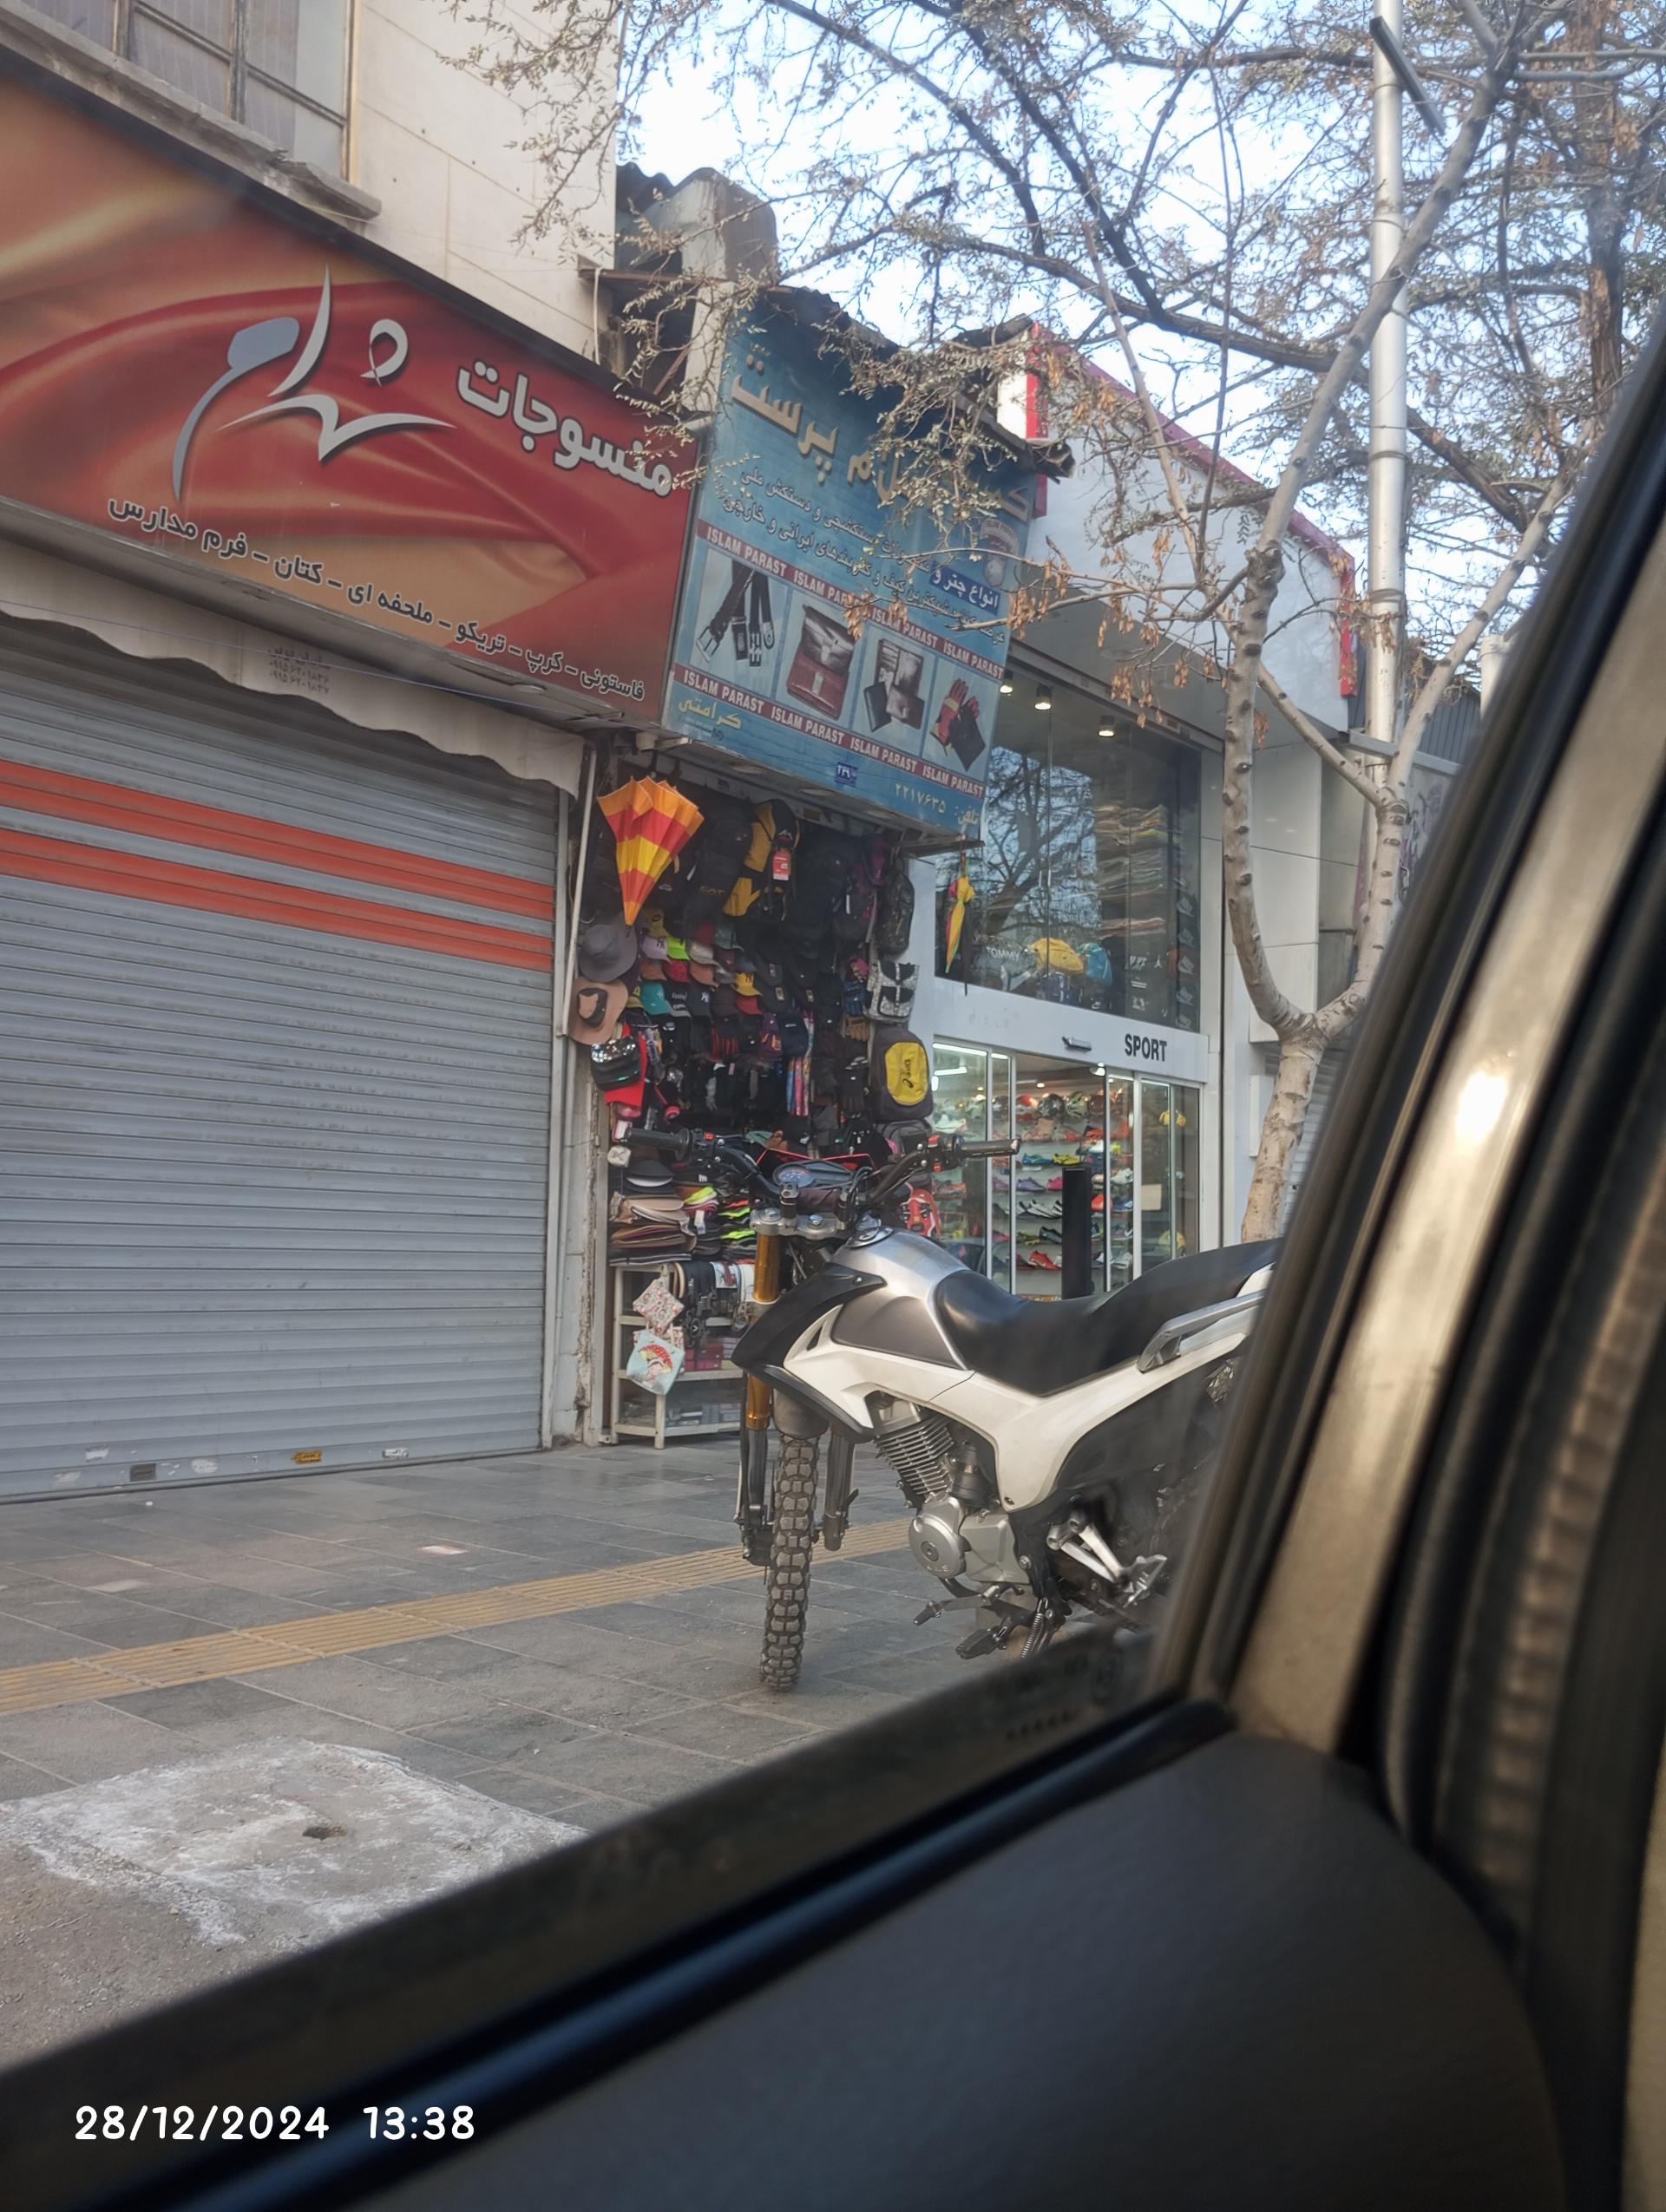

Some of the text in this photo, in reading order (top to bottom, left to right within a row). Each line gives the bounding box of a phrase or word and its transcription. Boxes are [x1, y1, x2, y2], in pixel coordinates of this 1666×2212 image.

[456, 360, 674, 498] منسوجات
[731, 353, 838, 487] پرست
[765, 480, 812, 512] دستکش
[108, 498, 199, 540] مدارس
[767, 517, 777, 534] و
[813, 507, 822, 522] و
[201, 528, 248, 560] فرم
[778, 521, 815, 553] ایرانی
[272, 556, 324, 586] کتان
[815, 540, 873, 577] کربندهای
[346, 582, 373, 605] ای
[873, 571, 882, 587] و
[377, 592, 434, 625] ملحفه
[707, 527, 742, 557] ISLAM
[744, 545, 788, 578] PARAST
[793, 569, 826, 598] ISLAM
[903, 623, 939, 648] PARAST
[942, 638, 971, 664] ISLAM
[970, 653, 1005, 680] PARAST
[969, 585, 999, 608] انواع
[454, 620, 507, 655] تریکو
[525, 649, 564, 675] کرپ
[580, 670, 646, 703] فاستونی
[678, 697, 743, 730] کرامتی
[684, 670, 984, 798] ISLAM PARAST ISLAM PARAST ISLAM PARAST ISLAM PARAST
[986, 946, 1020, 961] TOMMY
[1124, 1033, 1168, 1063] SPORT
